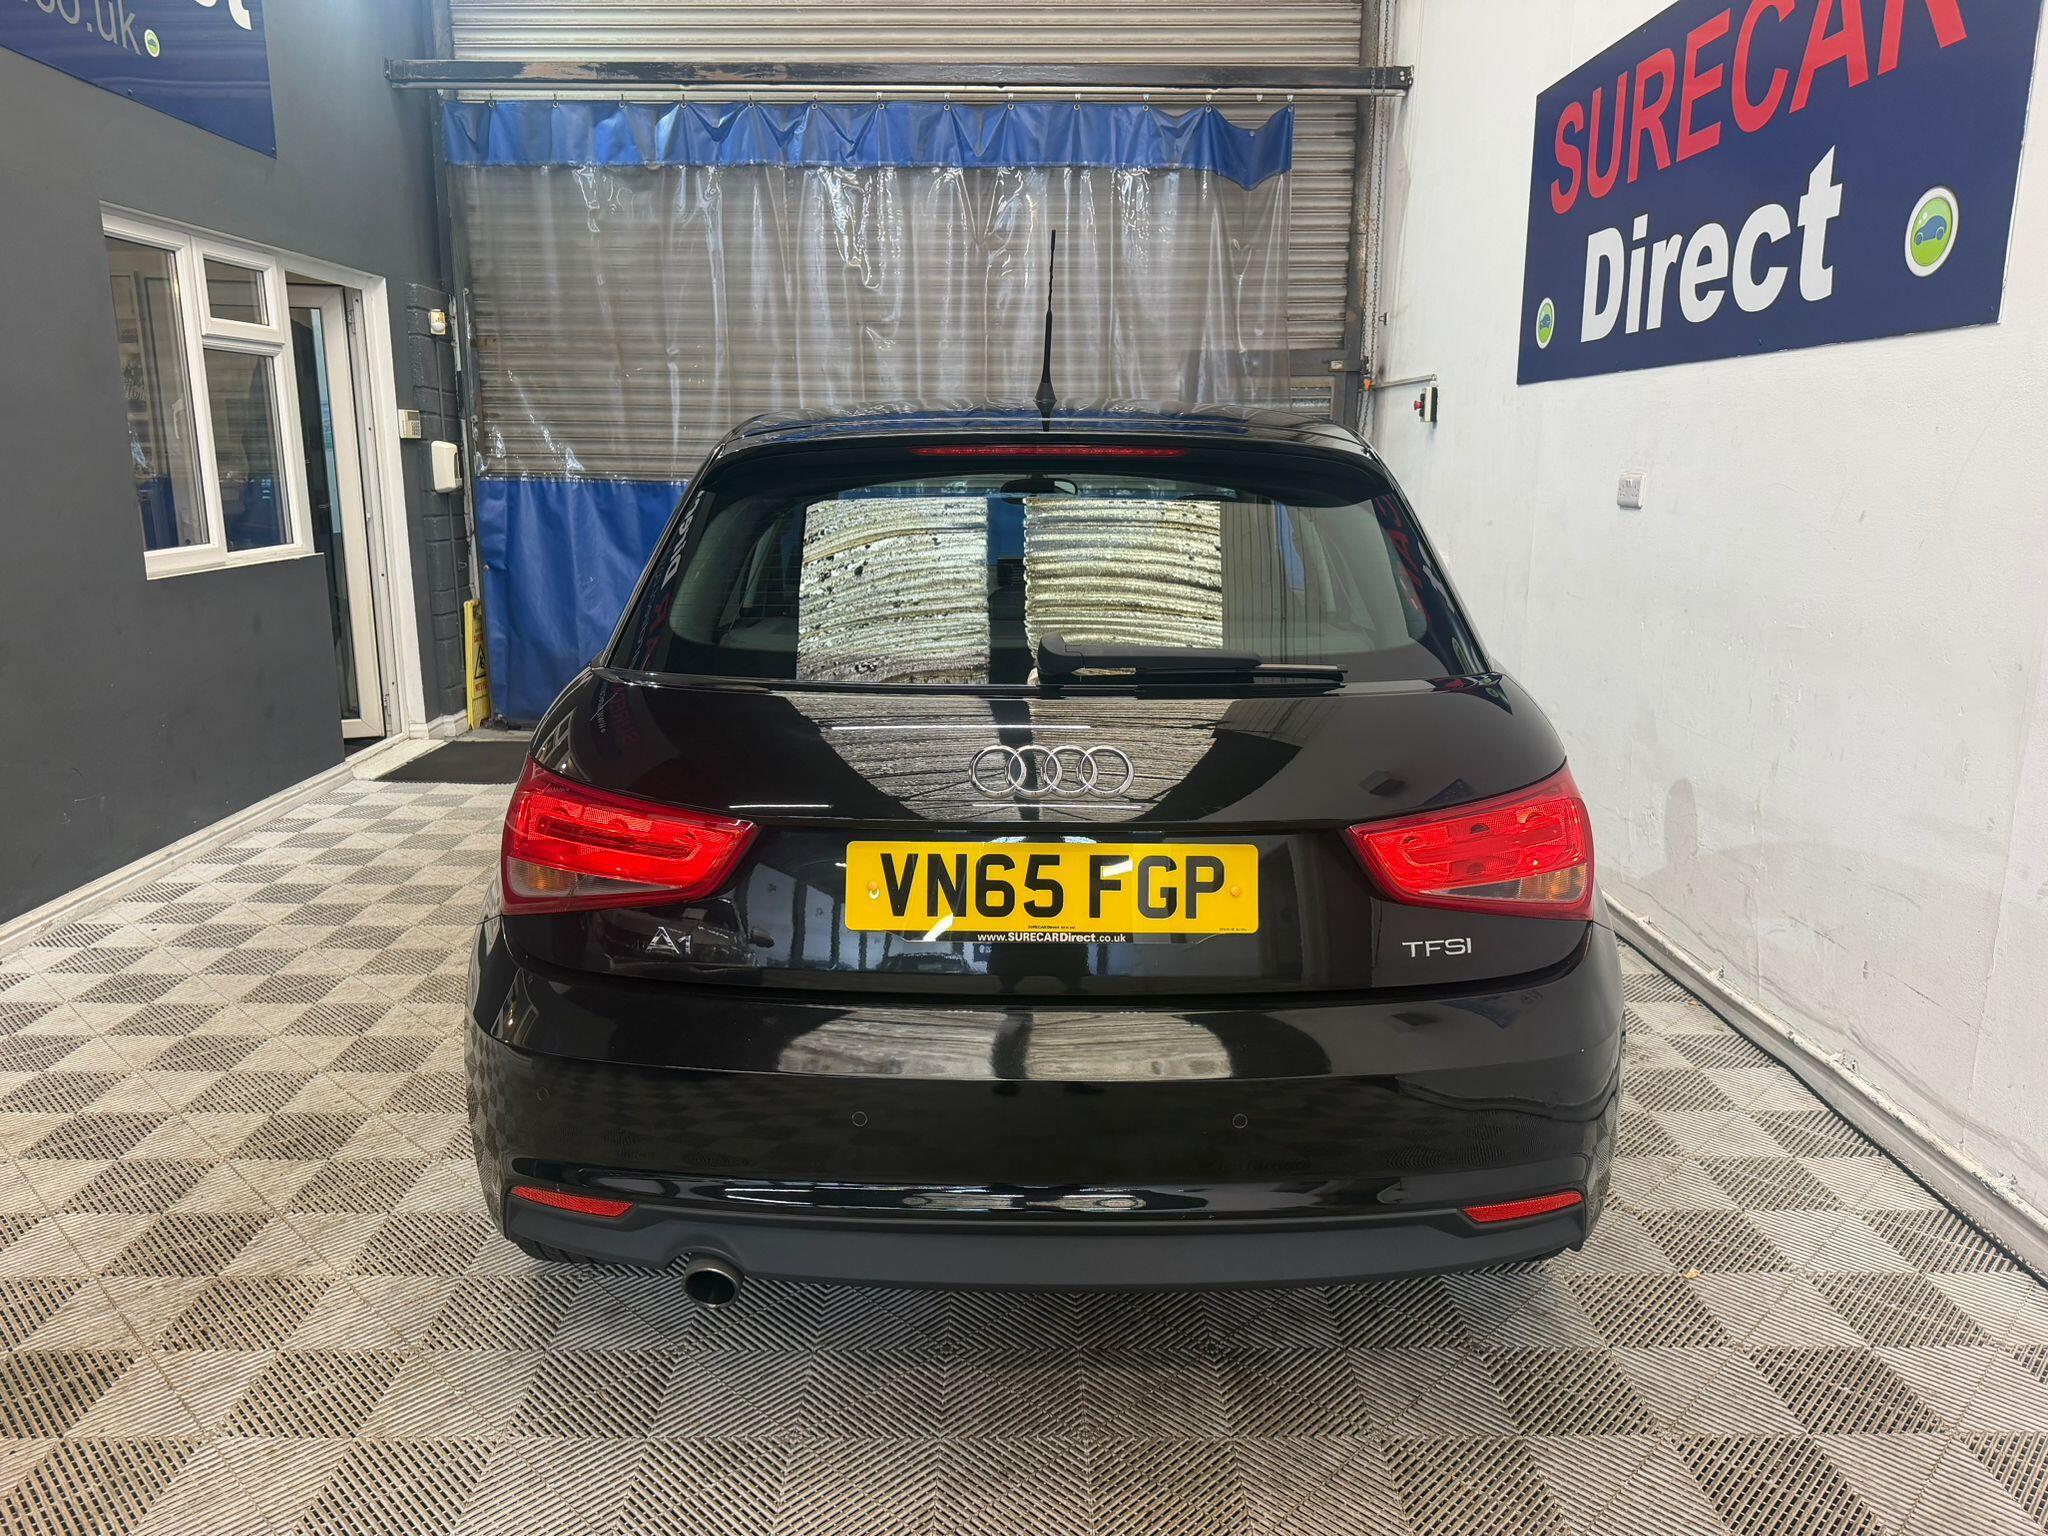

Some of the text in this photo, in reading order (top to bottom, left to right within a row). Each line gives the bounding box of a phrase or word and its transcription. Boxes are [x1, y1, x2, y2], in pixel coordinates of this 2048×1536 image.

[1580, 144, 1843, 343] Direct
[880, 853, 1225, 919] VN65 FGP
[645, 926, 691, 954] A1
[977, 932, 1126, 943] www.SURECARDirect.co.uk
[1401, 937, 1472, 958] TFSI
